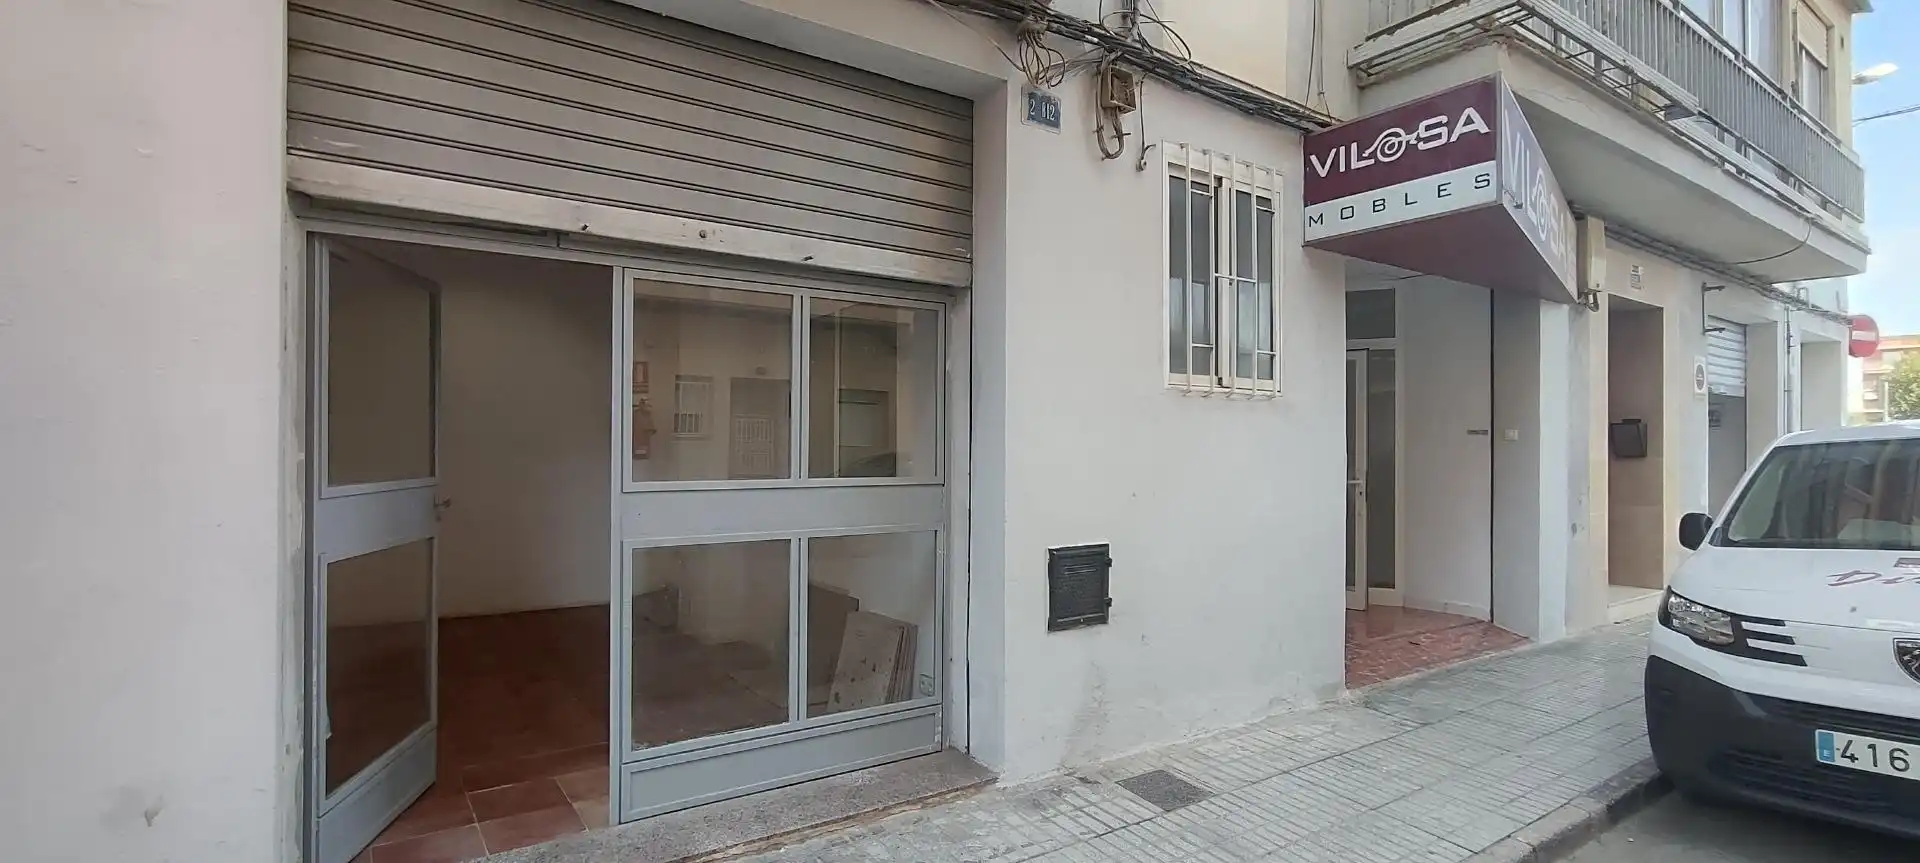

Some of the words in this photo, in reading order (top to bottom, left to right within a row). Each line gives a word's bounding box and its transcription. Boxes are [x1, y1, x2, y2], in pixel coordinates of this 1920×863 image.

[1309, 106, 1491, 178] VILOSA
[1308, 172, 1491, 228] MOBLES
[1841, 739, 1910, 772] 416
